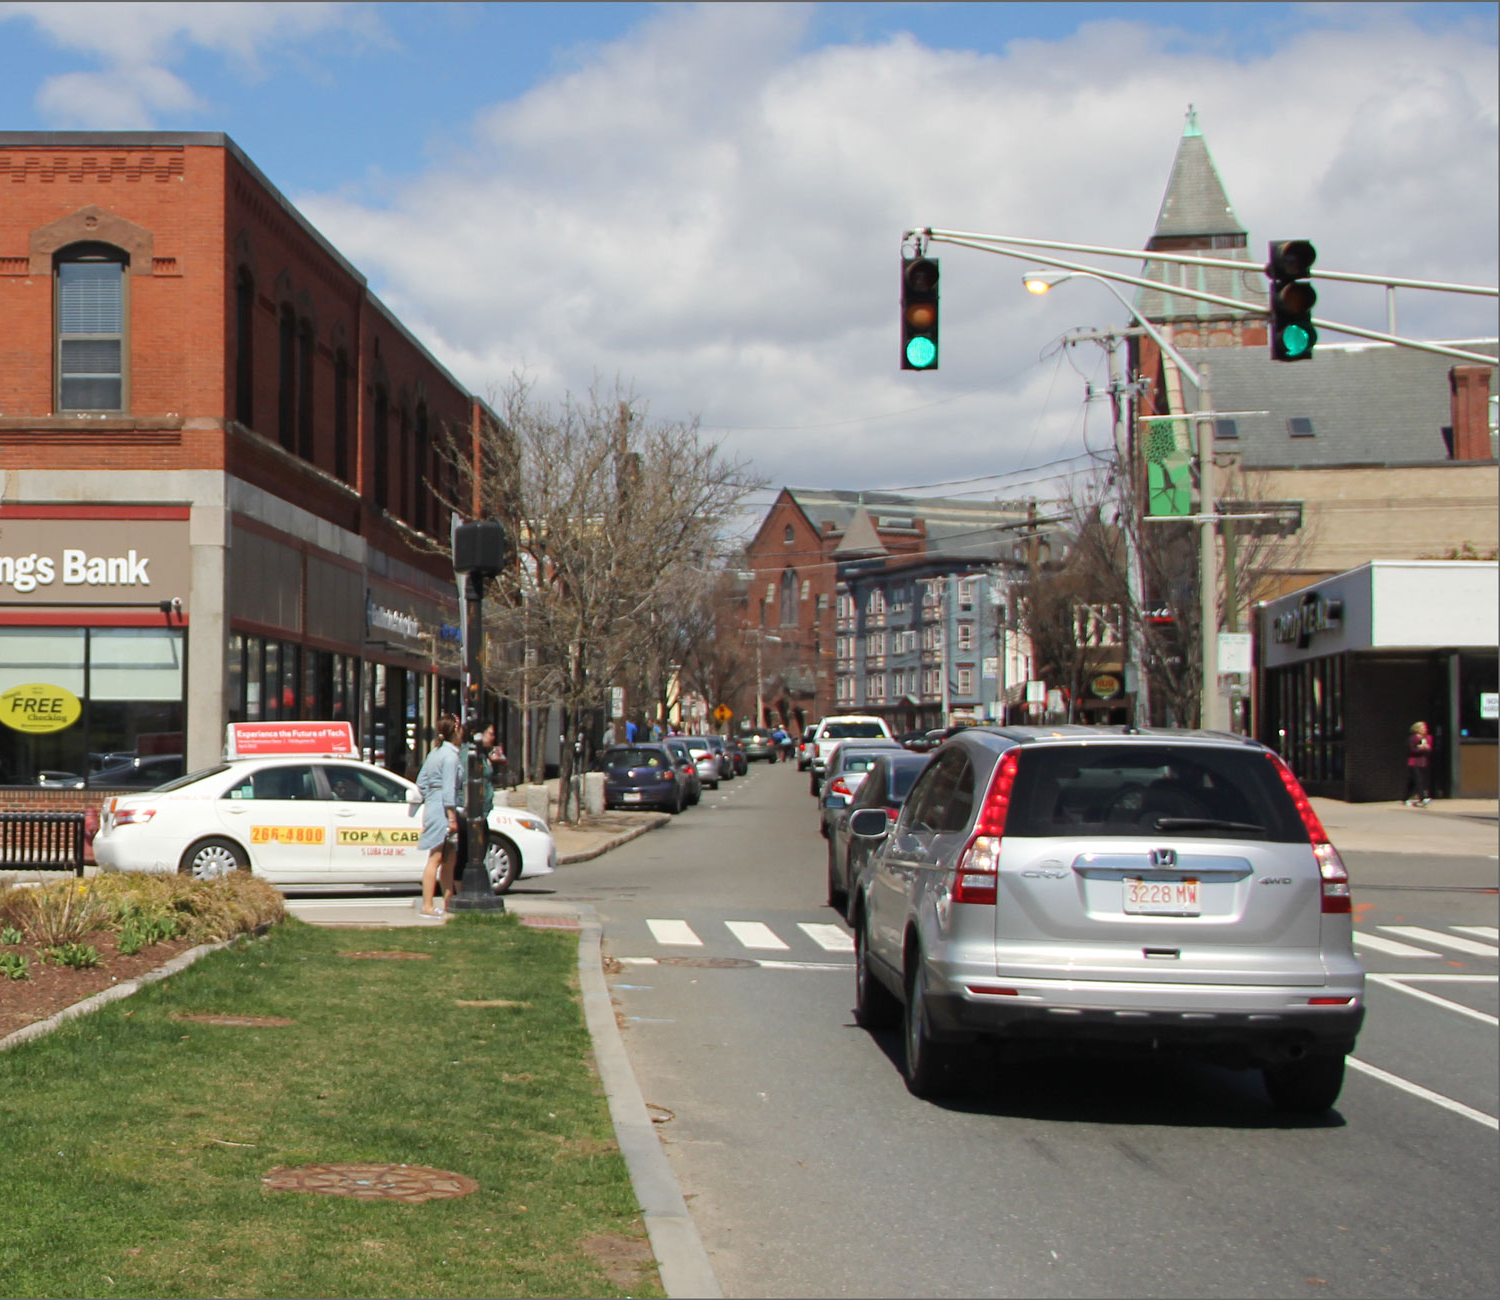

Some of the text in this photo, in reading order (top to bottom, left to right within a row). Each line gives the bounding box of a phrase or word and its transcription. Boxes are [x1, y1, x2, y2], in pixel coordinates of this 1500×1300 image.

[63, 549, 150, 584] Bank
[11, 698, 64, 713] FREE
[27, 714, 67, 723] Checking
[236, 728, 347, 739] Experience the Future of Tech.
[252, 827, 323, 843] 266-4800
[340, 831, 420, 842] TOP CAB
[1128, 884, 1197, 904] 3228 MW
